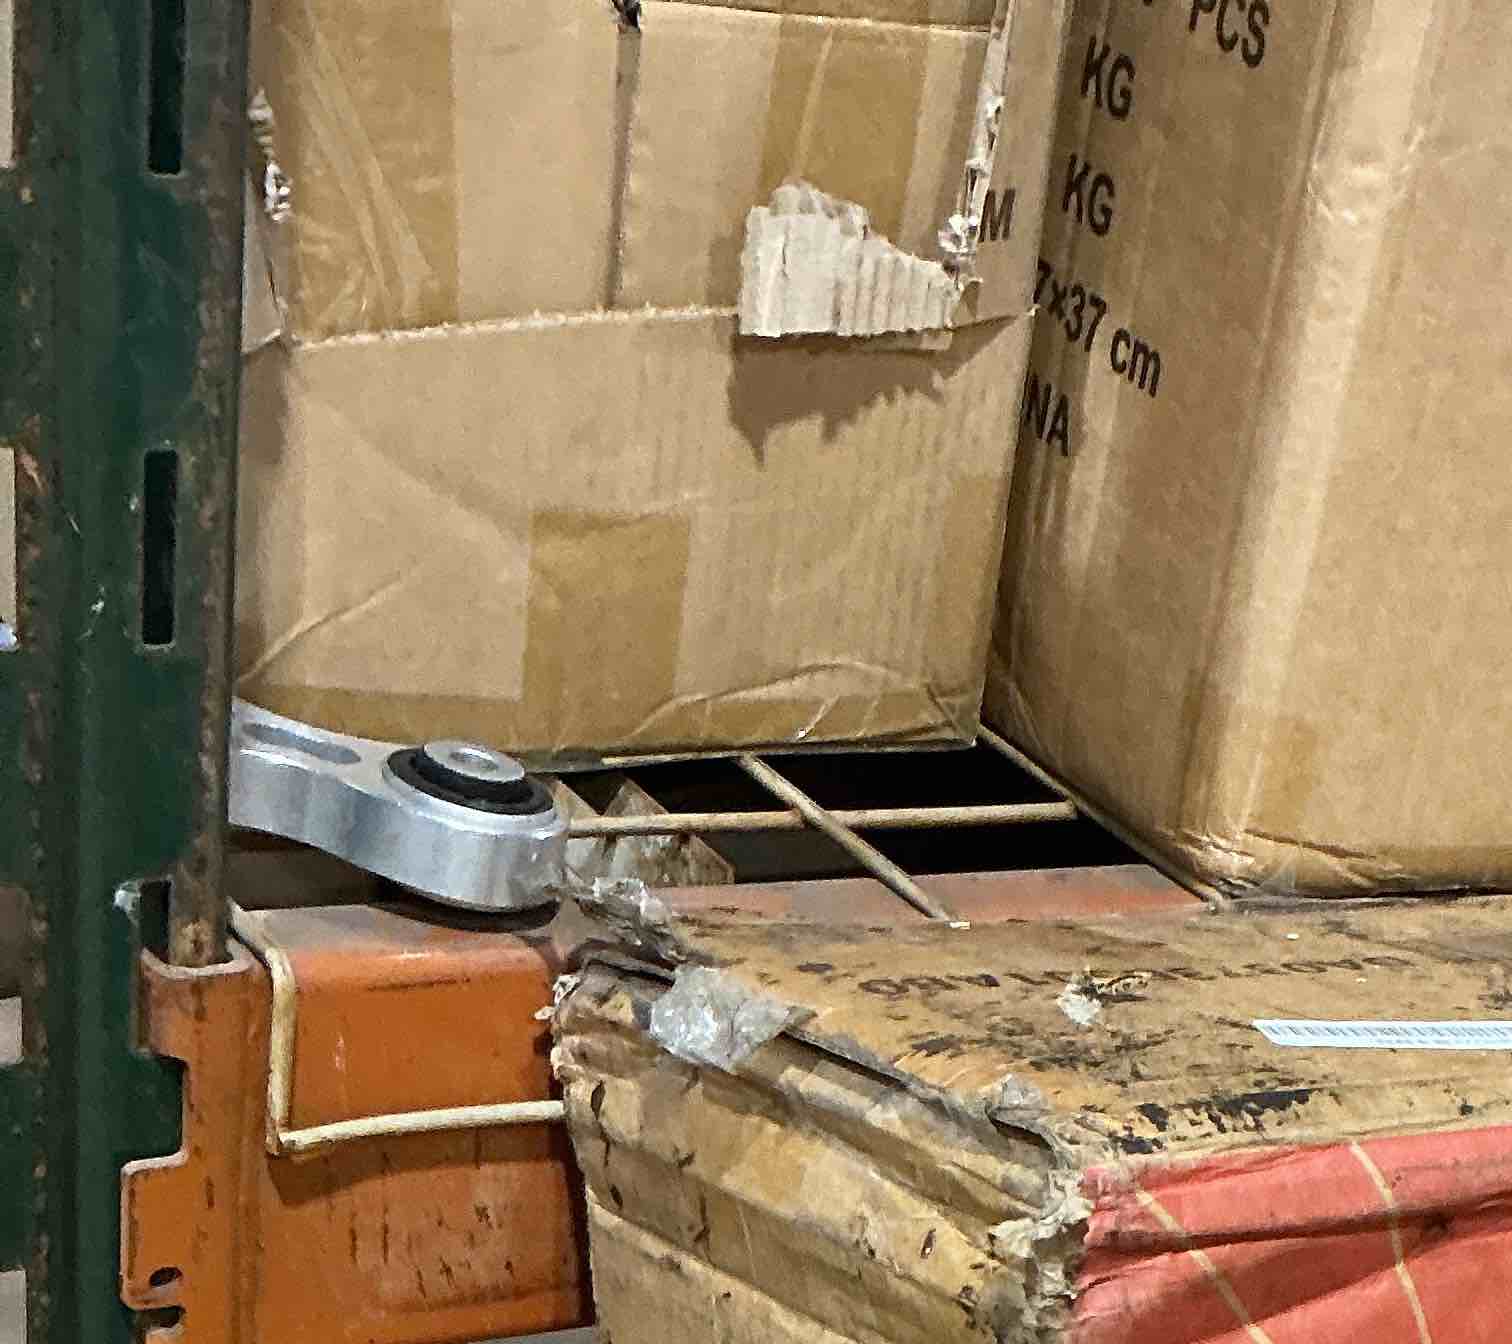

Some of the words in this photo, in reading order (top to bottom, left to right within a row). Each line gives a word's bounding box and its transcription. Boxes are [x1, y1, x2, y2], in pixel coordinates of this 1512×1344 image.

[1081, 36, 1136, 120] KG
[1061, 153, 1115, 237] KG
[1109, 327, 1162, 398] cm
